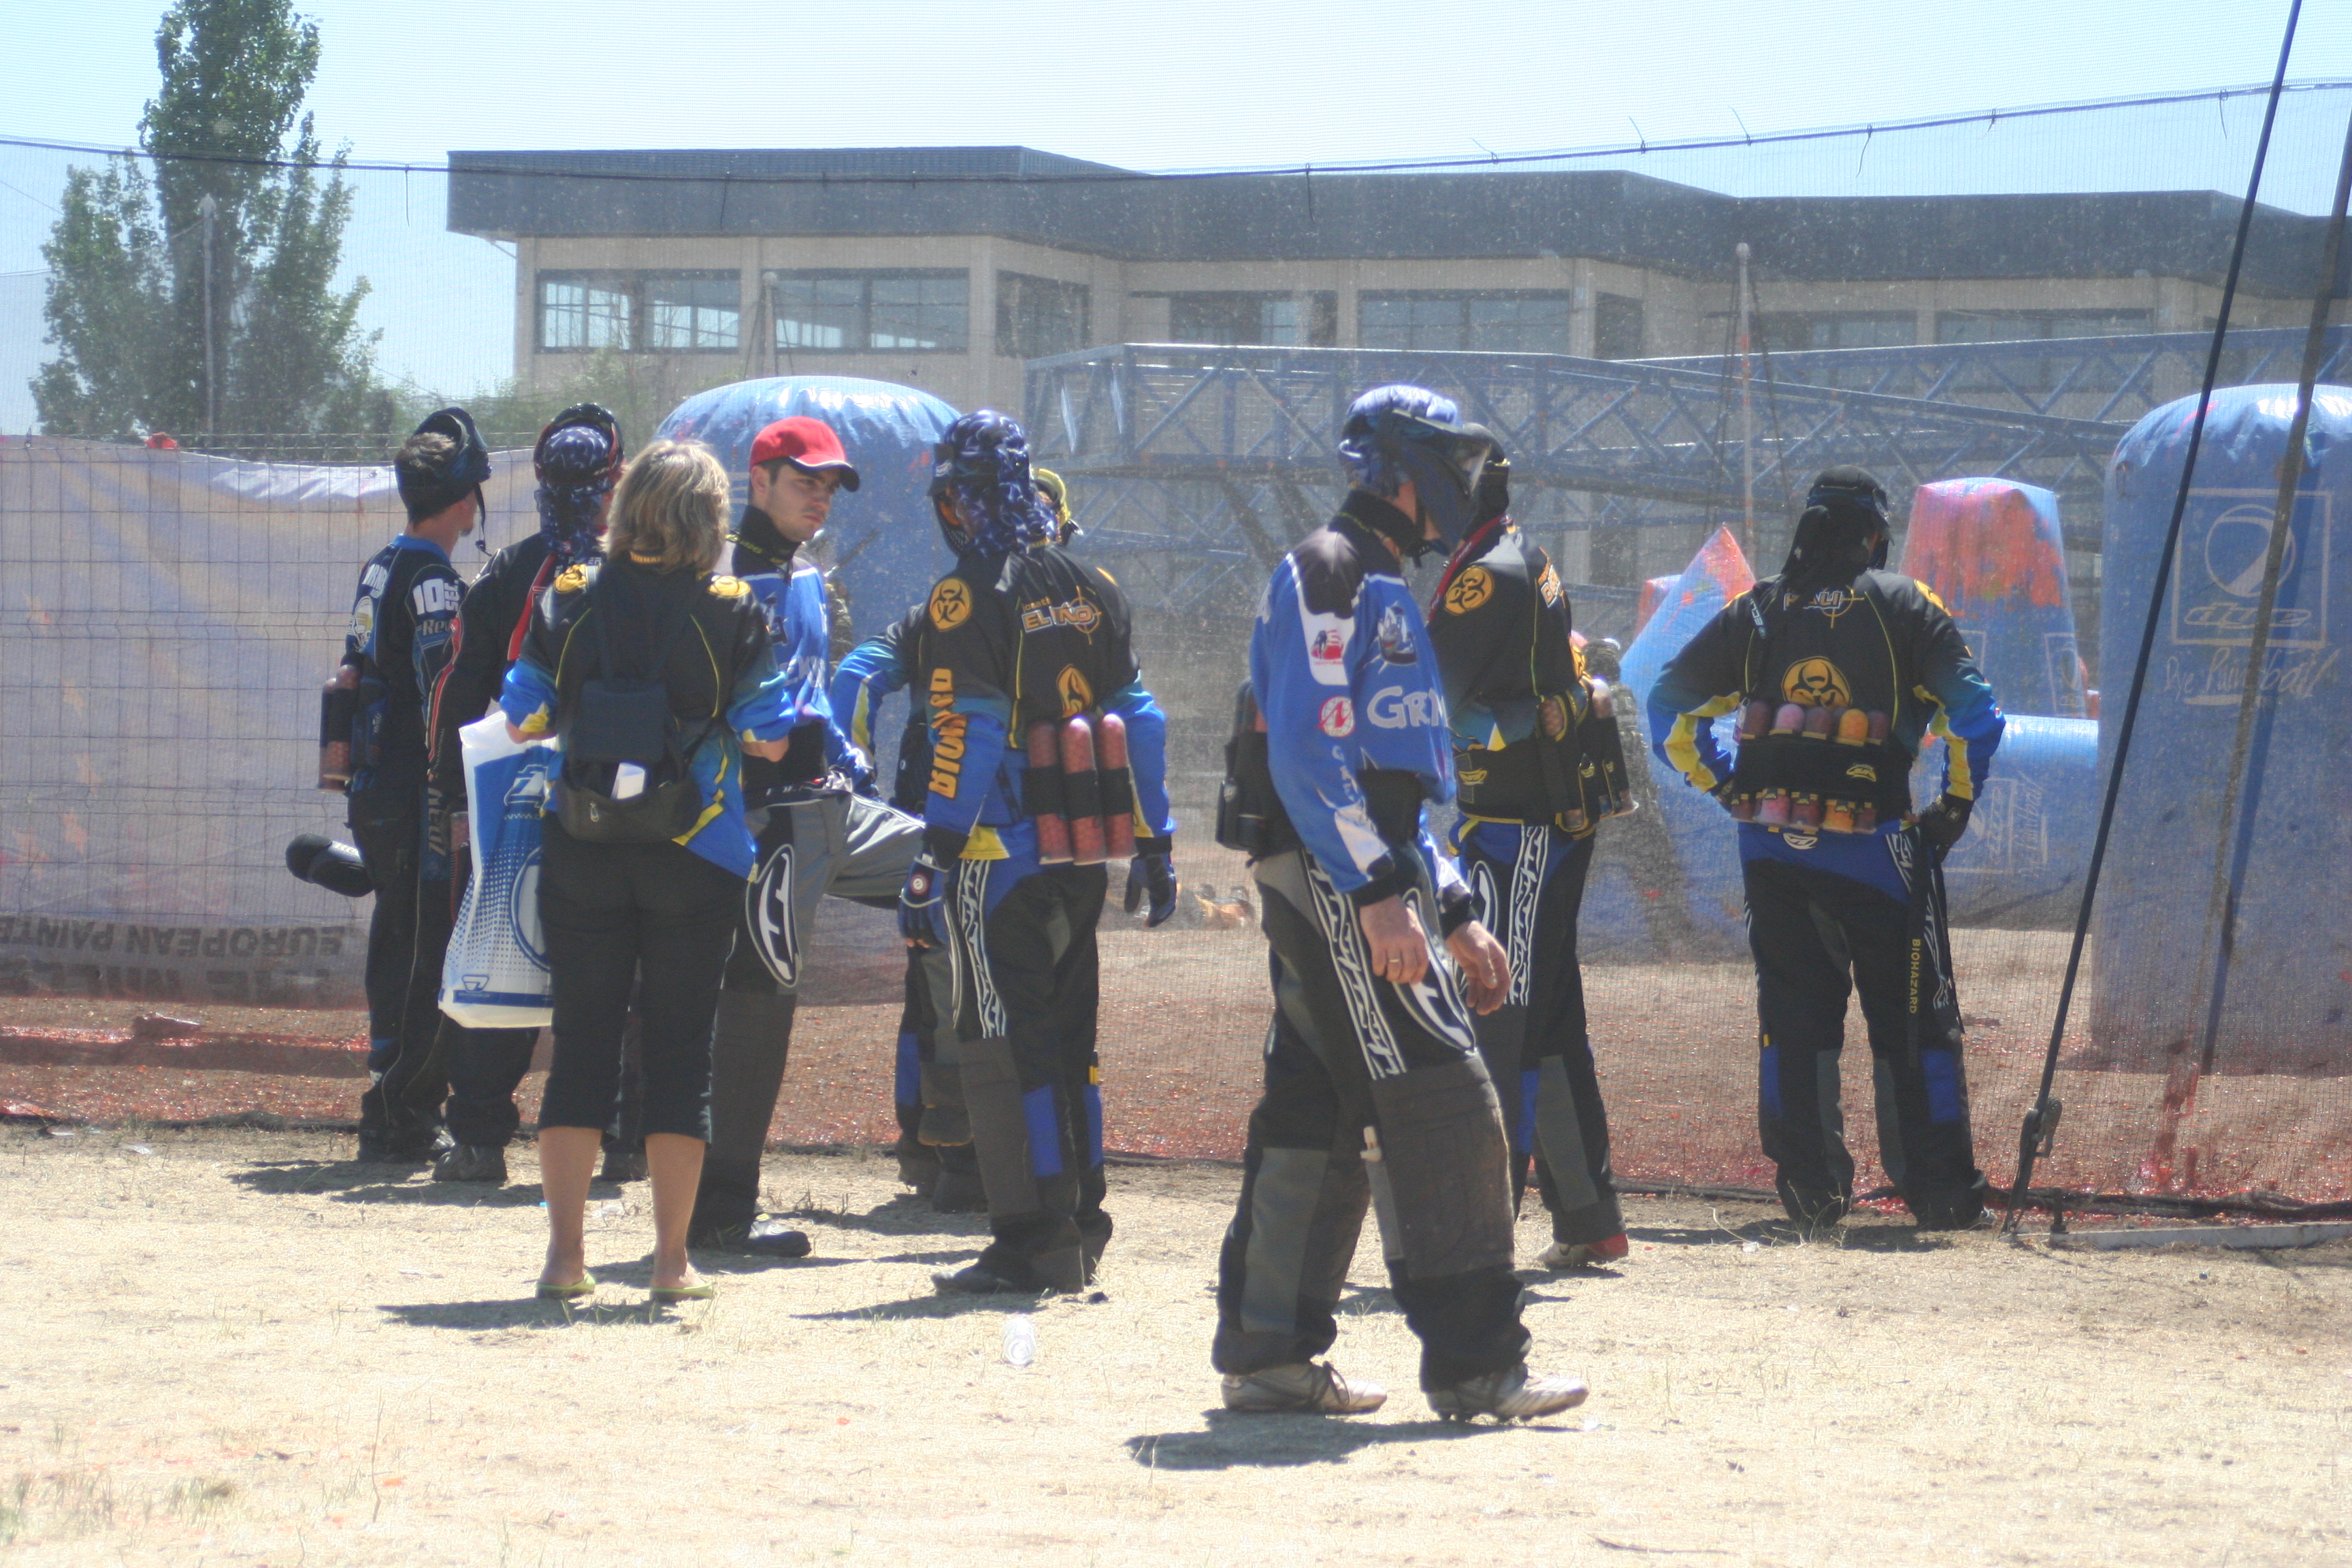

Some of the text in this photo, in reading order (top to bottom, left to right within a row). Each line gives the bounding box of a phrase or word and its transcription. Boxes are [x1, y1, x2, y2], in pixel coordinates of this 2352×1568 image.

[412, 578, 446, 615] 10
[125, 924, 345, 958] EUROPEAN
[1909, 938, 1921, 1014] BIOHAZARD
